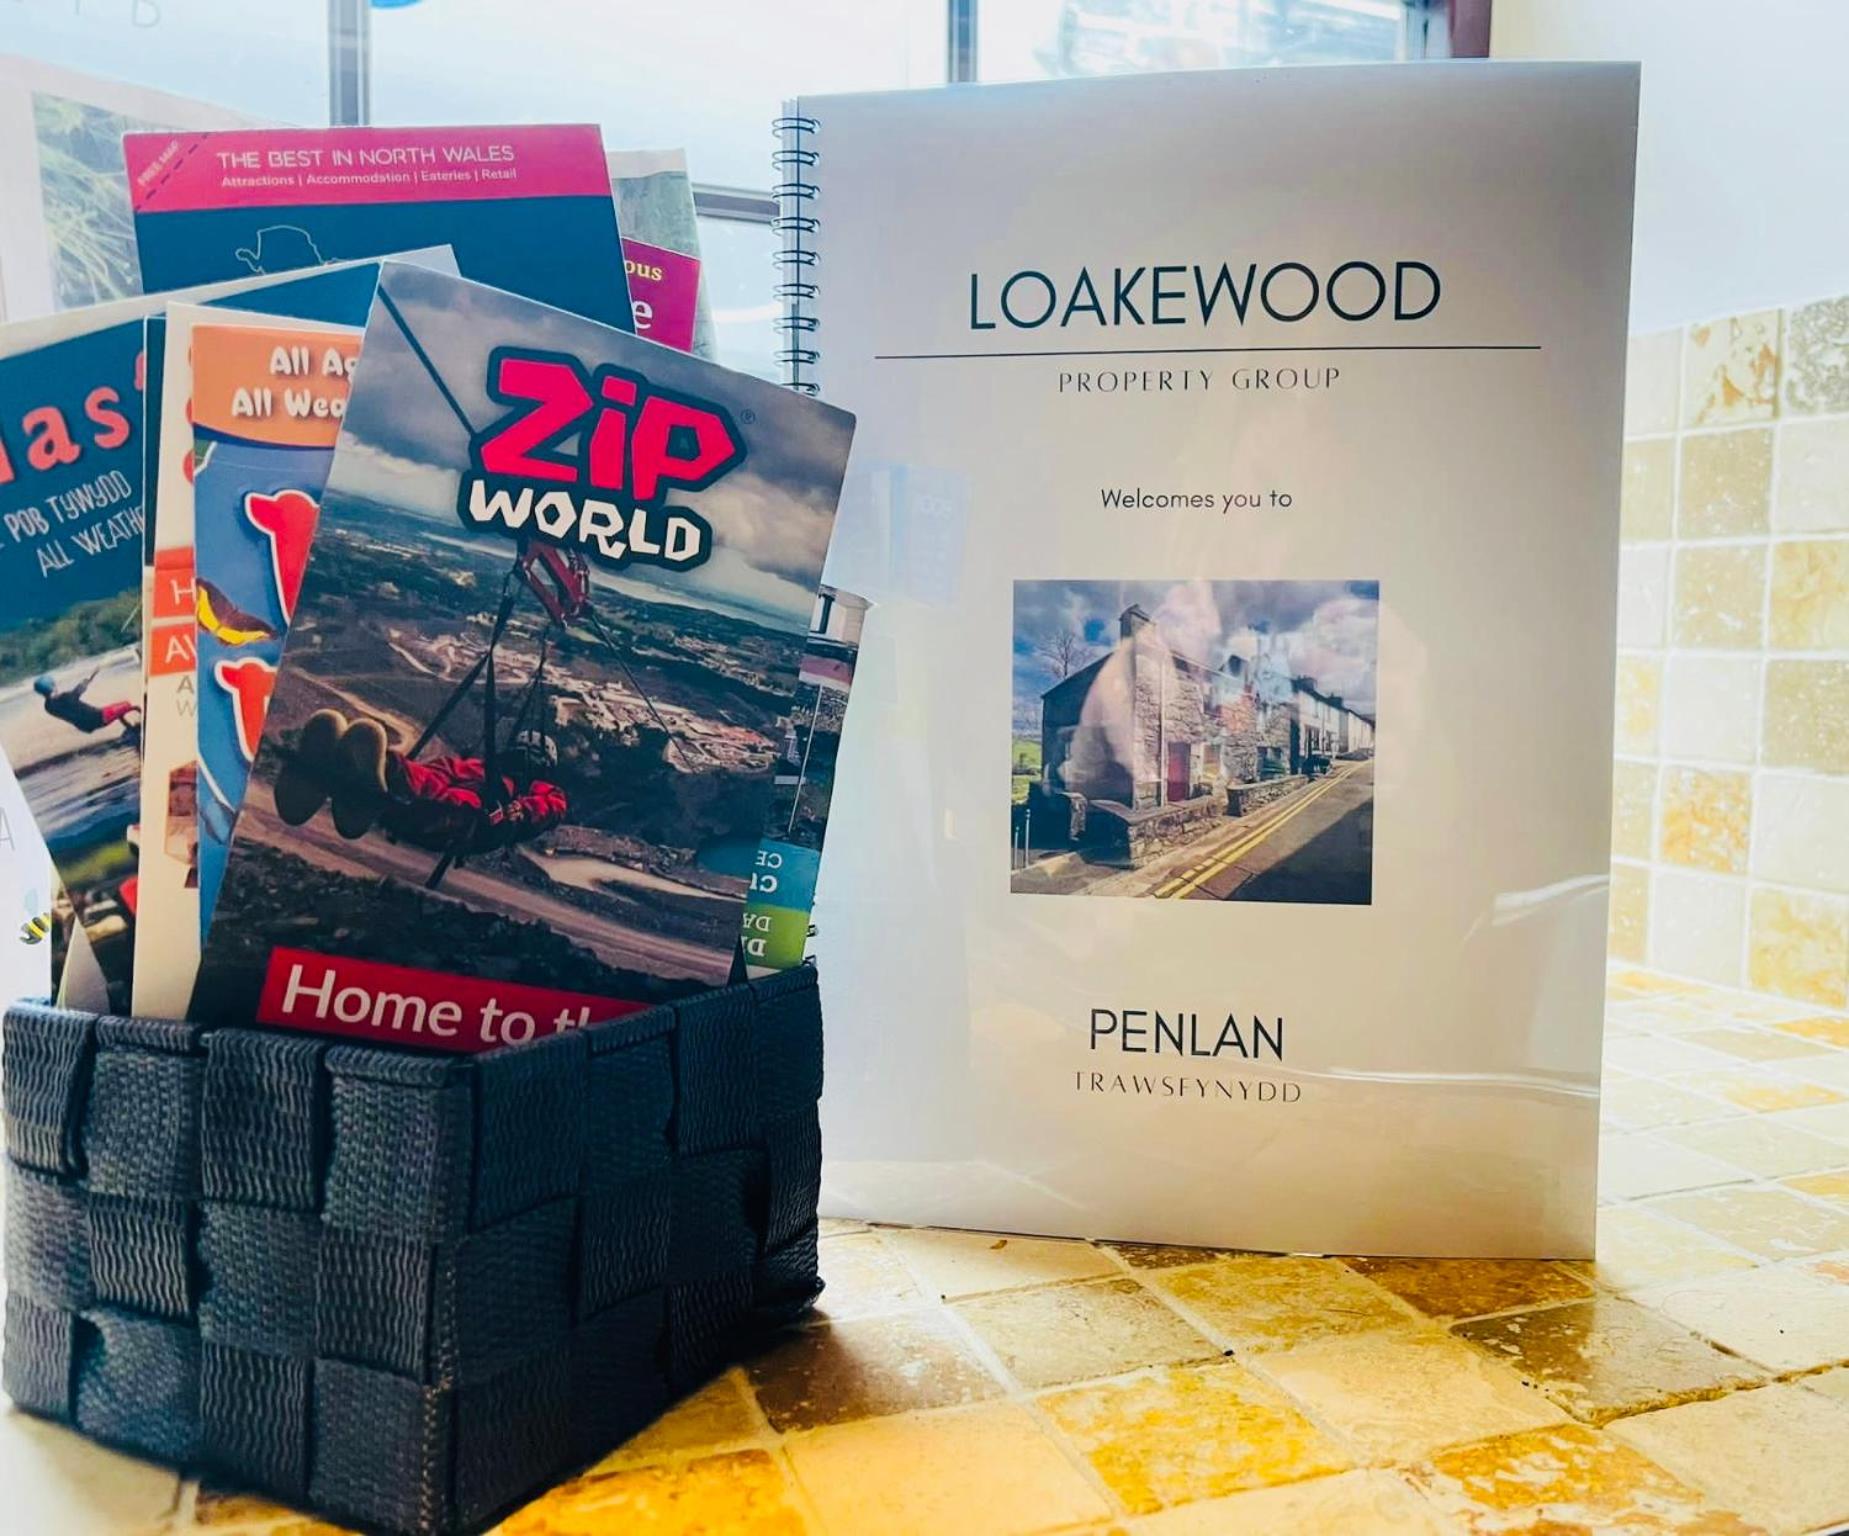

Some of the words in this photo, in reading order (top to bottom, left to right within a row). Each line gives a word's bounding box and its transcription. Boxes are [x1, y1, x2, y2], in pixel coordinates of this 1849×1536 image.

[217, 151, 260, 169] THE
[267, 150, 322, 168] BEST
[333, 149, 353, 166] IN
[359, 147, 436, 165] NORTH
[442, 145, 515, 163] WALES
[221, 174, 295, 187] Attractions
[306, 171, 411, 185] Accommodation
[421, 169, 471, 183] Eateries
[481, 167, 517, 180] Retail
[970, 260, 1441, 330] LOAKEWOOD
[270, 346, 309, 376] All
[1059, 370, 1213, 393] PROPERTY
[1231, 367, 1341, 391] GROUP
[231, 387, 272, 418] All
[481, 358, 736, 500] Zip
[4, 507, 50, 543] POB
[46, 470, 132, 524] TYWYDD
[1101, 488, 1214, 509] Welcomes
[1222, 492, 1261, 514] you
[1269, 489, 1293, 508] to
[469, 479, 702, 562] WORLD
[36, 539, 75, 578] ALL
[281, 964, 463, 1038] Home
[479, 998, 536, 1046] to
[1090, 1008, 1284, 1062] PENLAN
[1075, 1071, 1302, 1103] TRAWSFYNYDD
